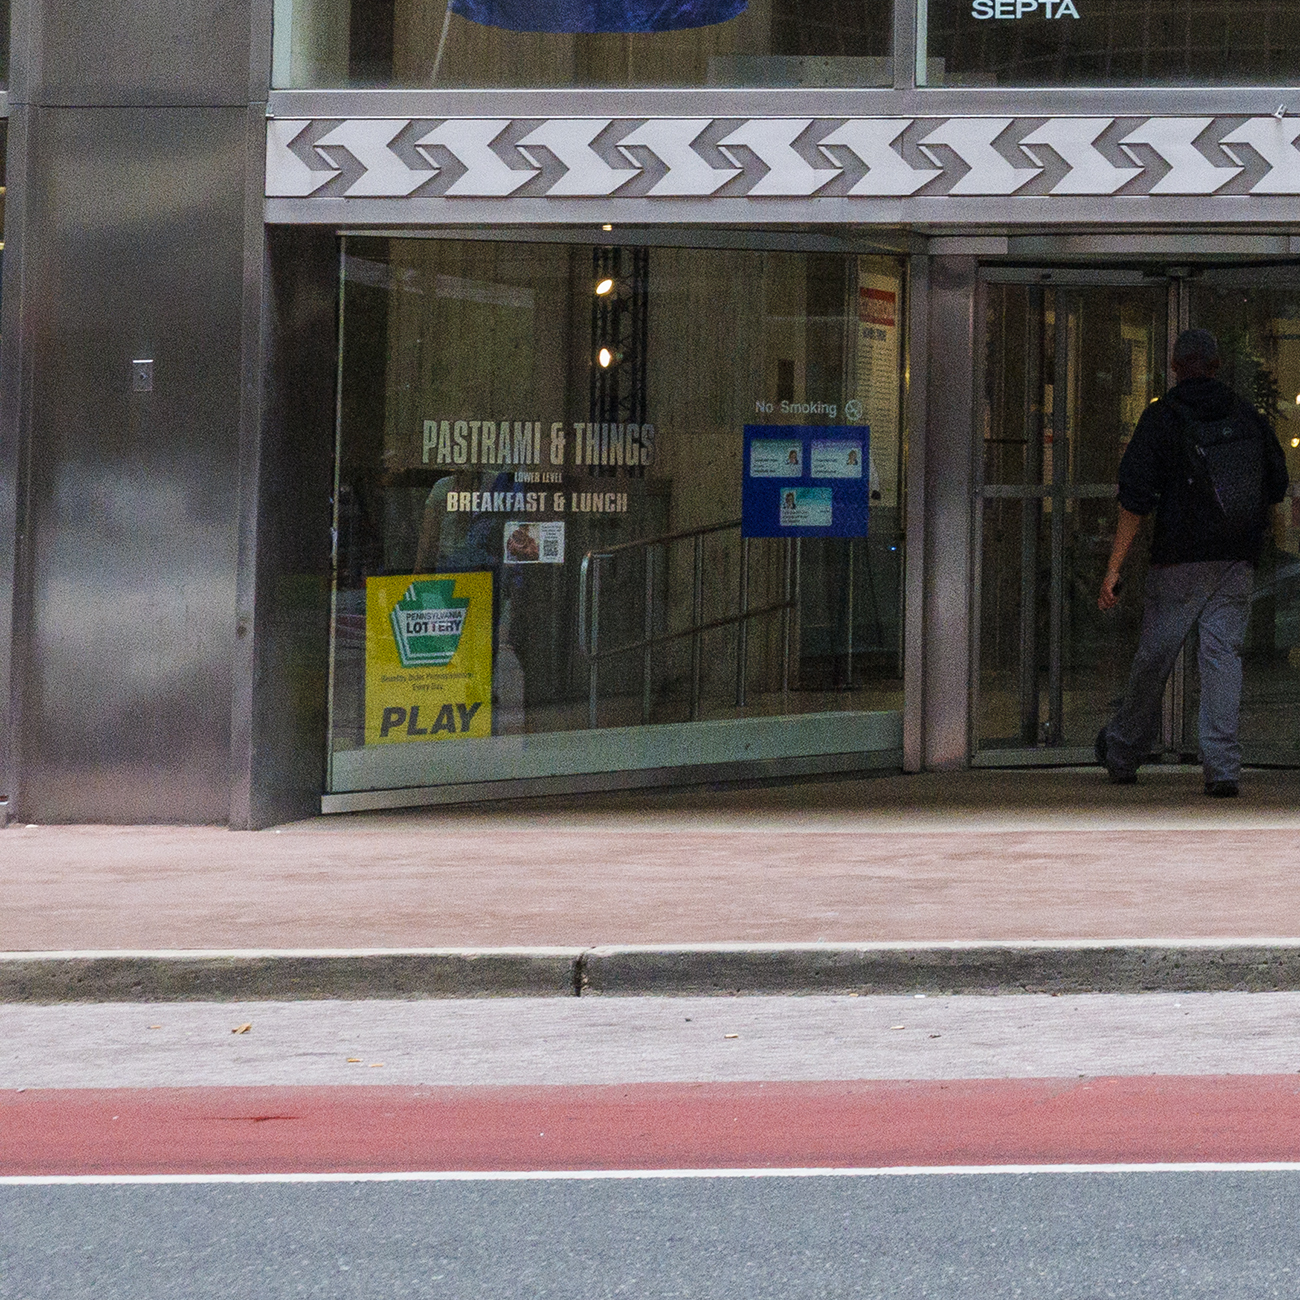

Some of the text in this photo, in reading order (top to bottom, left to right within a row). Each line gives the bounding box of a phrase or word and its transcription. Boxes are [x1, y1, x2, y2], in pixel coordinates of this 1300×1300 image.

[755, 400, 837, 418] No Smoking
[422, 419, 655, 466] PASTRAMI & THINGS
[514, 471, 563, 483] LOWER LEVEL
[446, 491, 628, 512] BREAKFAST & LUNCH
[406, 611, 462, 621] PENNSYLVANIA
[406, 620, 462, 634] LOTTERY
[379, 702, 482, 738] PLAY
